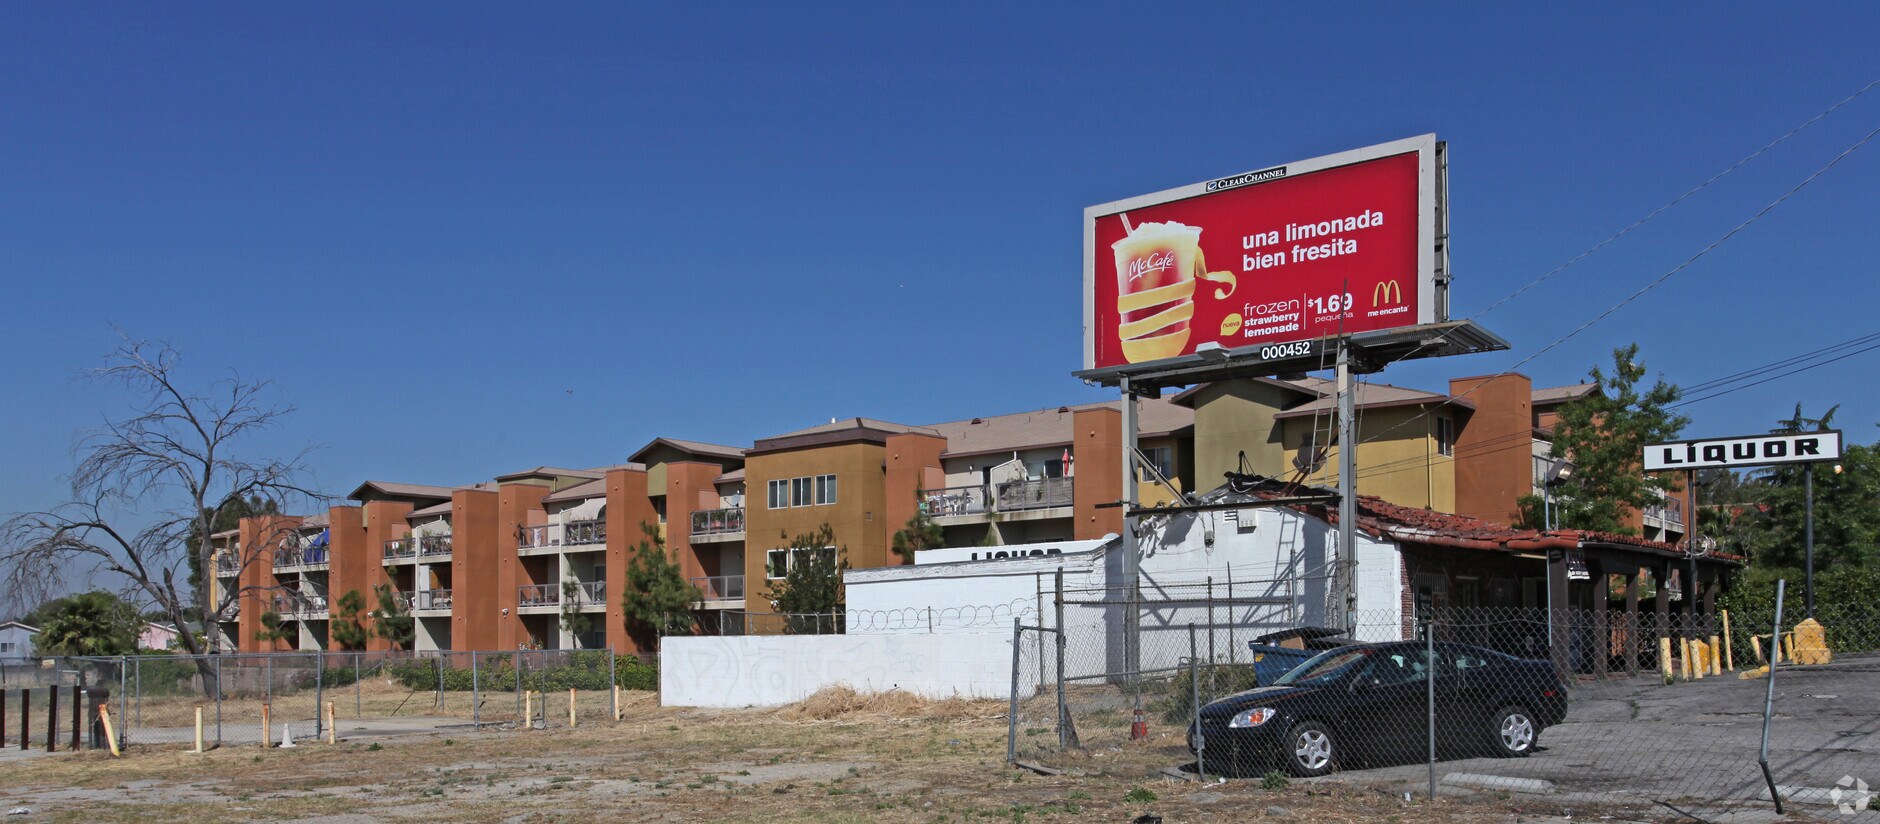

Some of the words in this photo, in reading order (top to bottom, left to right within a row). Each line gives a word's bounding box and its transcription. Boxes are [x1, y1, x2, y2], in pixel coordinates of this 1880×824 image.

[1242, 230, 1279, 250] una
[1285, 209, 1384, 242] limonada
[1129, 250, 1174, 278] McCafé
[1242, 251, 1286, 272] bien
[1291, 238, 1358, 263] fresita
[1243, 299, 1300, 317] frozen
[1307, 292, 1353, 315] $1.69
[1367, 310, 1379, 318] me
[1379, 305, 1408, 315] encanta
[1222, 320, 1240, 329] nueva
[1244, 312, 1300, 327] strawberry
[1244, 322, 1300, 338] lemonade
[1261, 341, 1311, 360] 000452
[1663, 437, 1820, 465] LIQUOR
